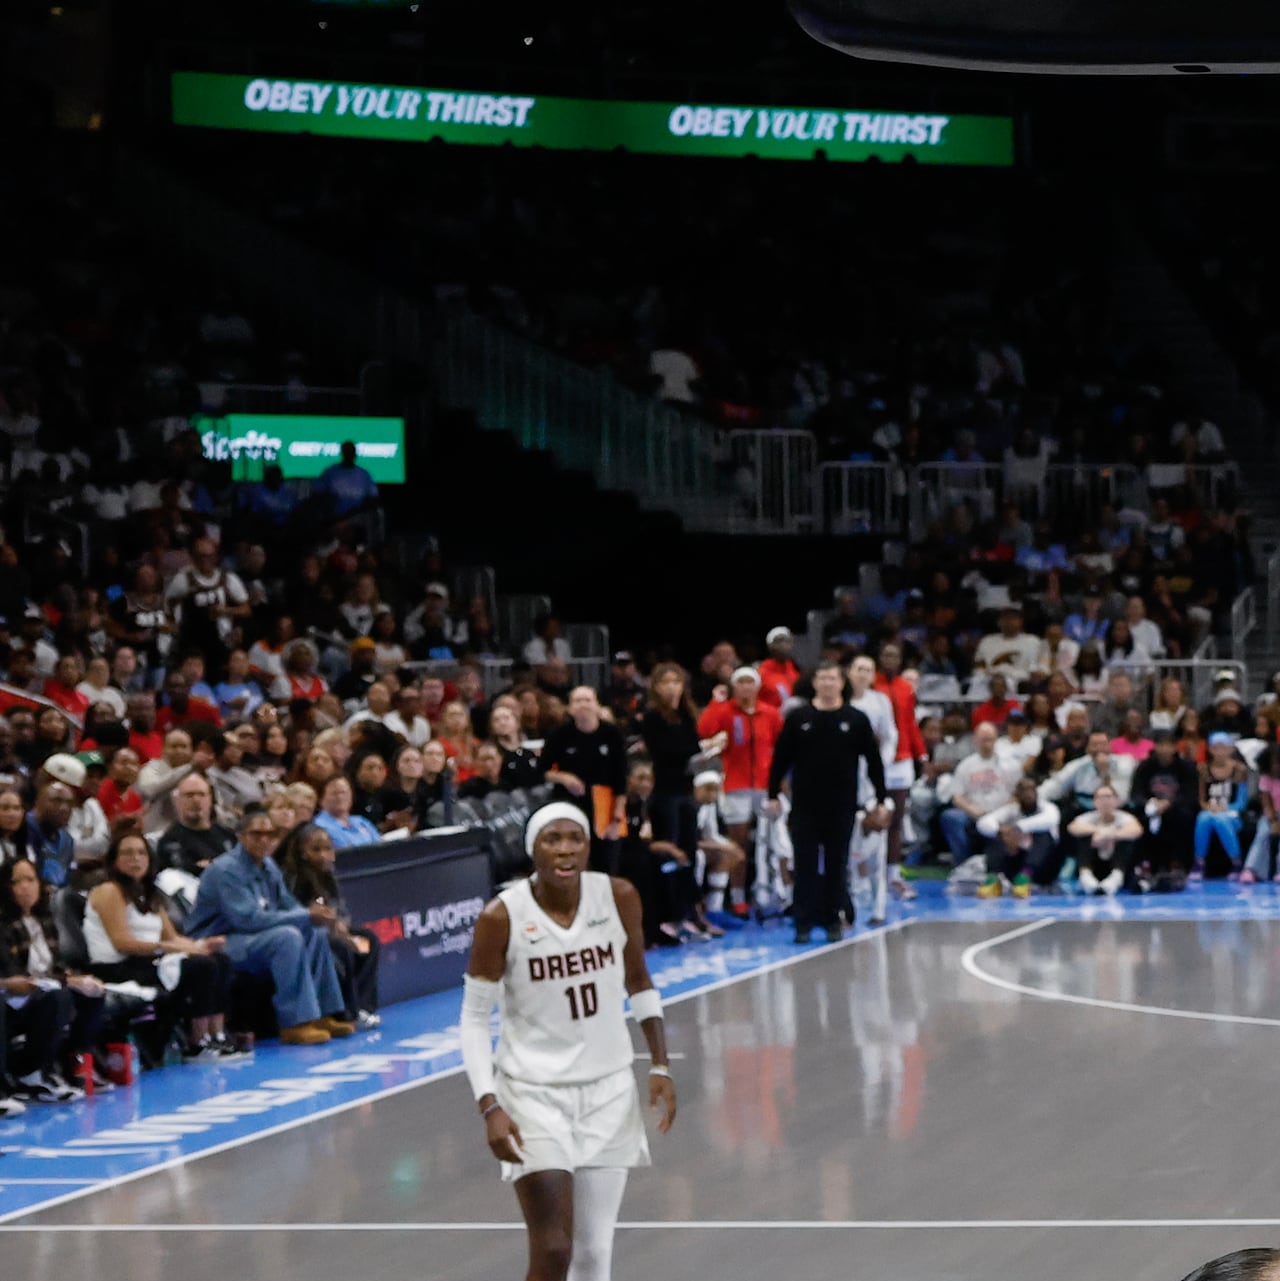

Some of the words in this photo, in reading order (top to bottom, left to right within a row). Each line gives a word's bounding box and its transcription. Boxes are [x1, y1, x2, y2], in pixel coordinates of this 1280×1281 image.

[244, 78, 332, 114] OBEY
[334, 86, 421, 120] YOUR
[426, 92, 535, 127] THIRST
[668, 105, 753, 138] OBEY
[755, 110, 839, 142] YOUR
[842, 113, 950, 146] THIRST
[528, 941, 615, 981] DREAM
[565, 982, 598, 1020] 10
